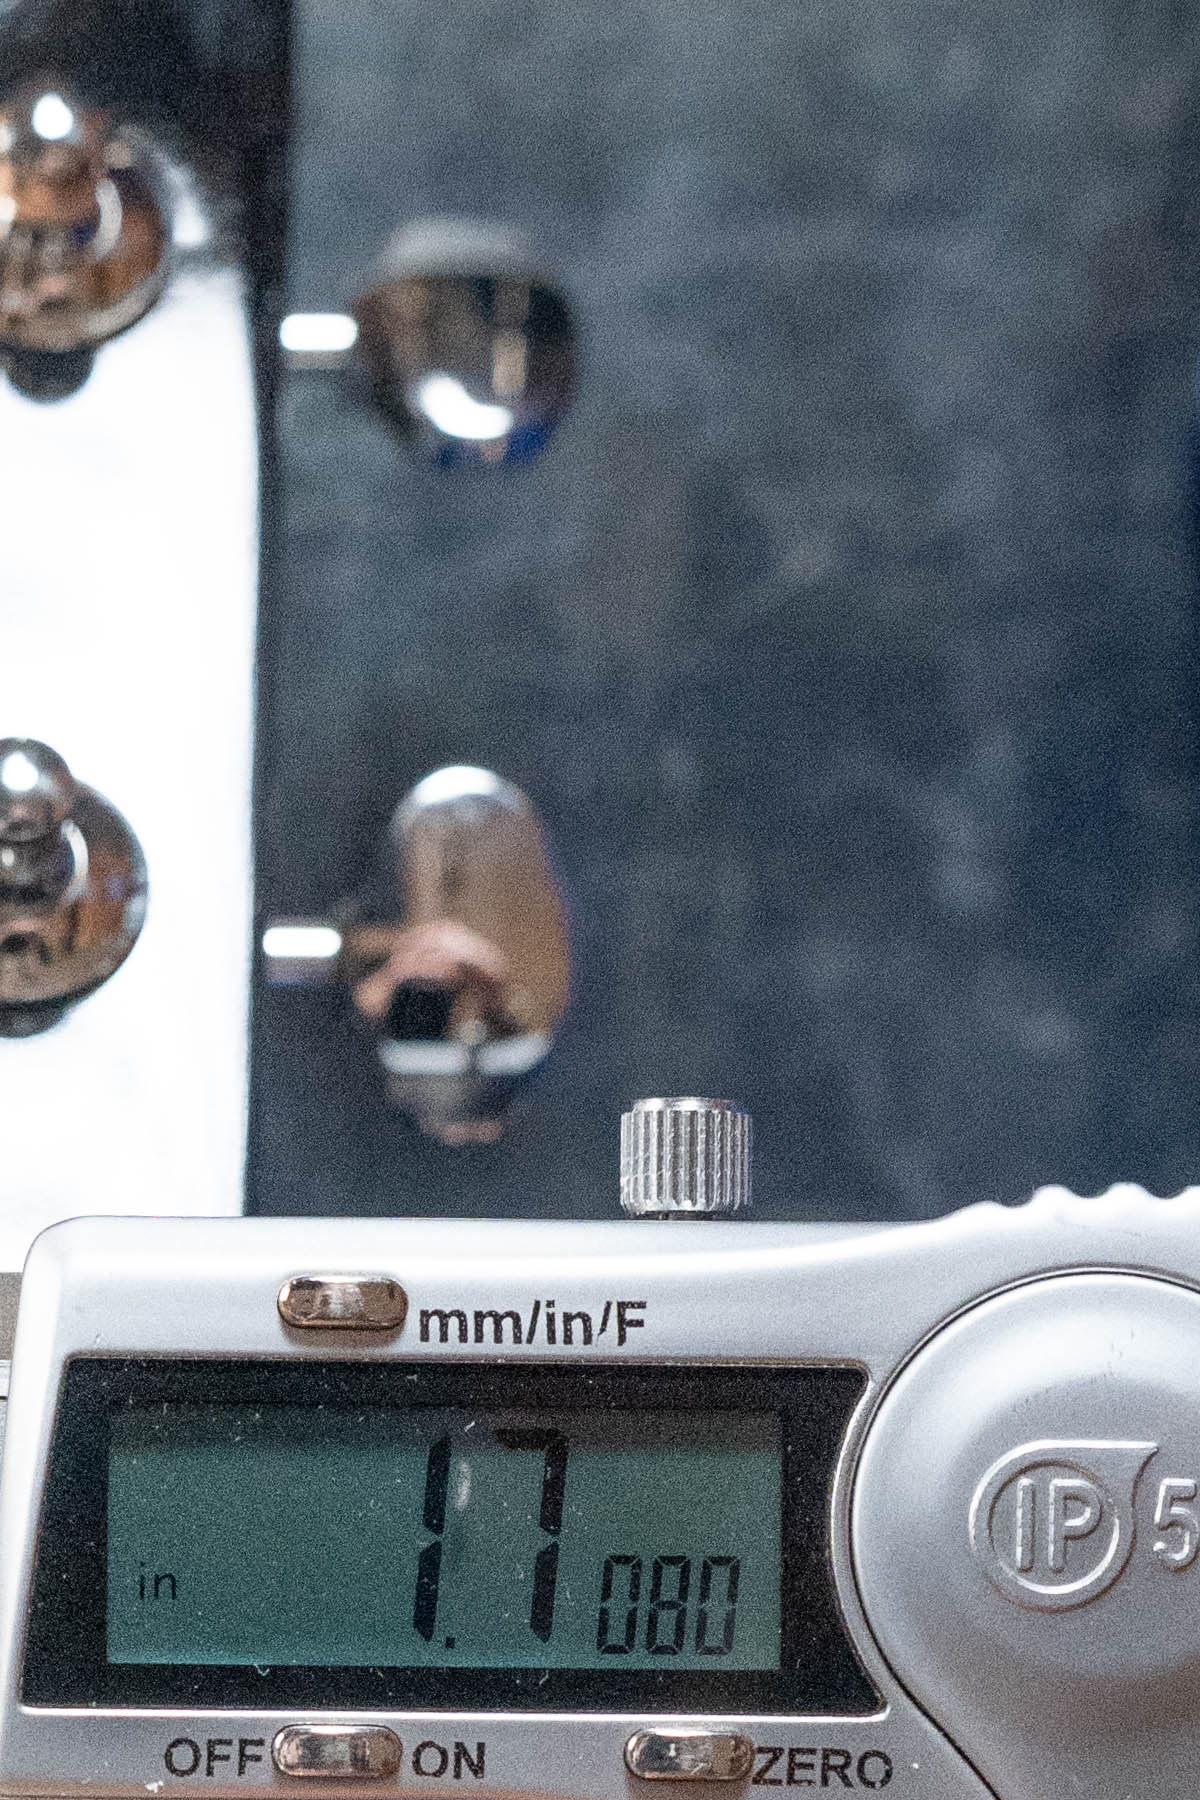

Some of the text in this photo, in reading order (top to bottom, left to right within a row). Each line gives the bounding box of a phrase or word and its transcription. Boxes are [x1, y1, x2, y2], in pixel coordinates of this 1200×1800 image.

[419, 1300, 647, 1347] mm/in/F
[1012, 1477, 1102, 1574] IP
[138, 1568, 177, 1602] in
[162, 1736, 487, 1781] OFF ON
[755, 1744, 895, 1792] ZERO
